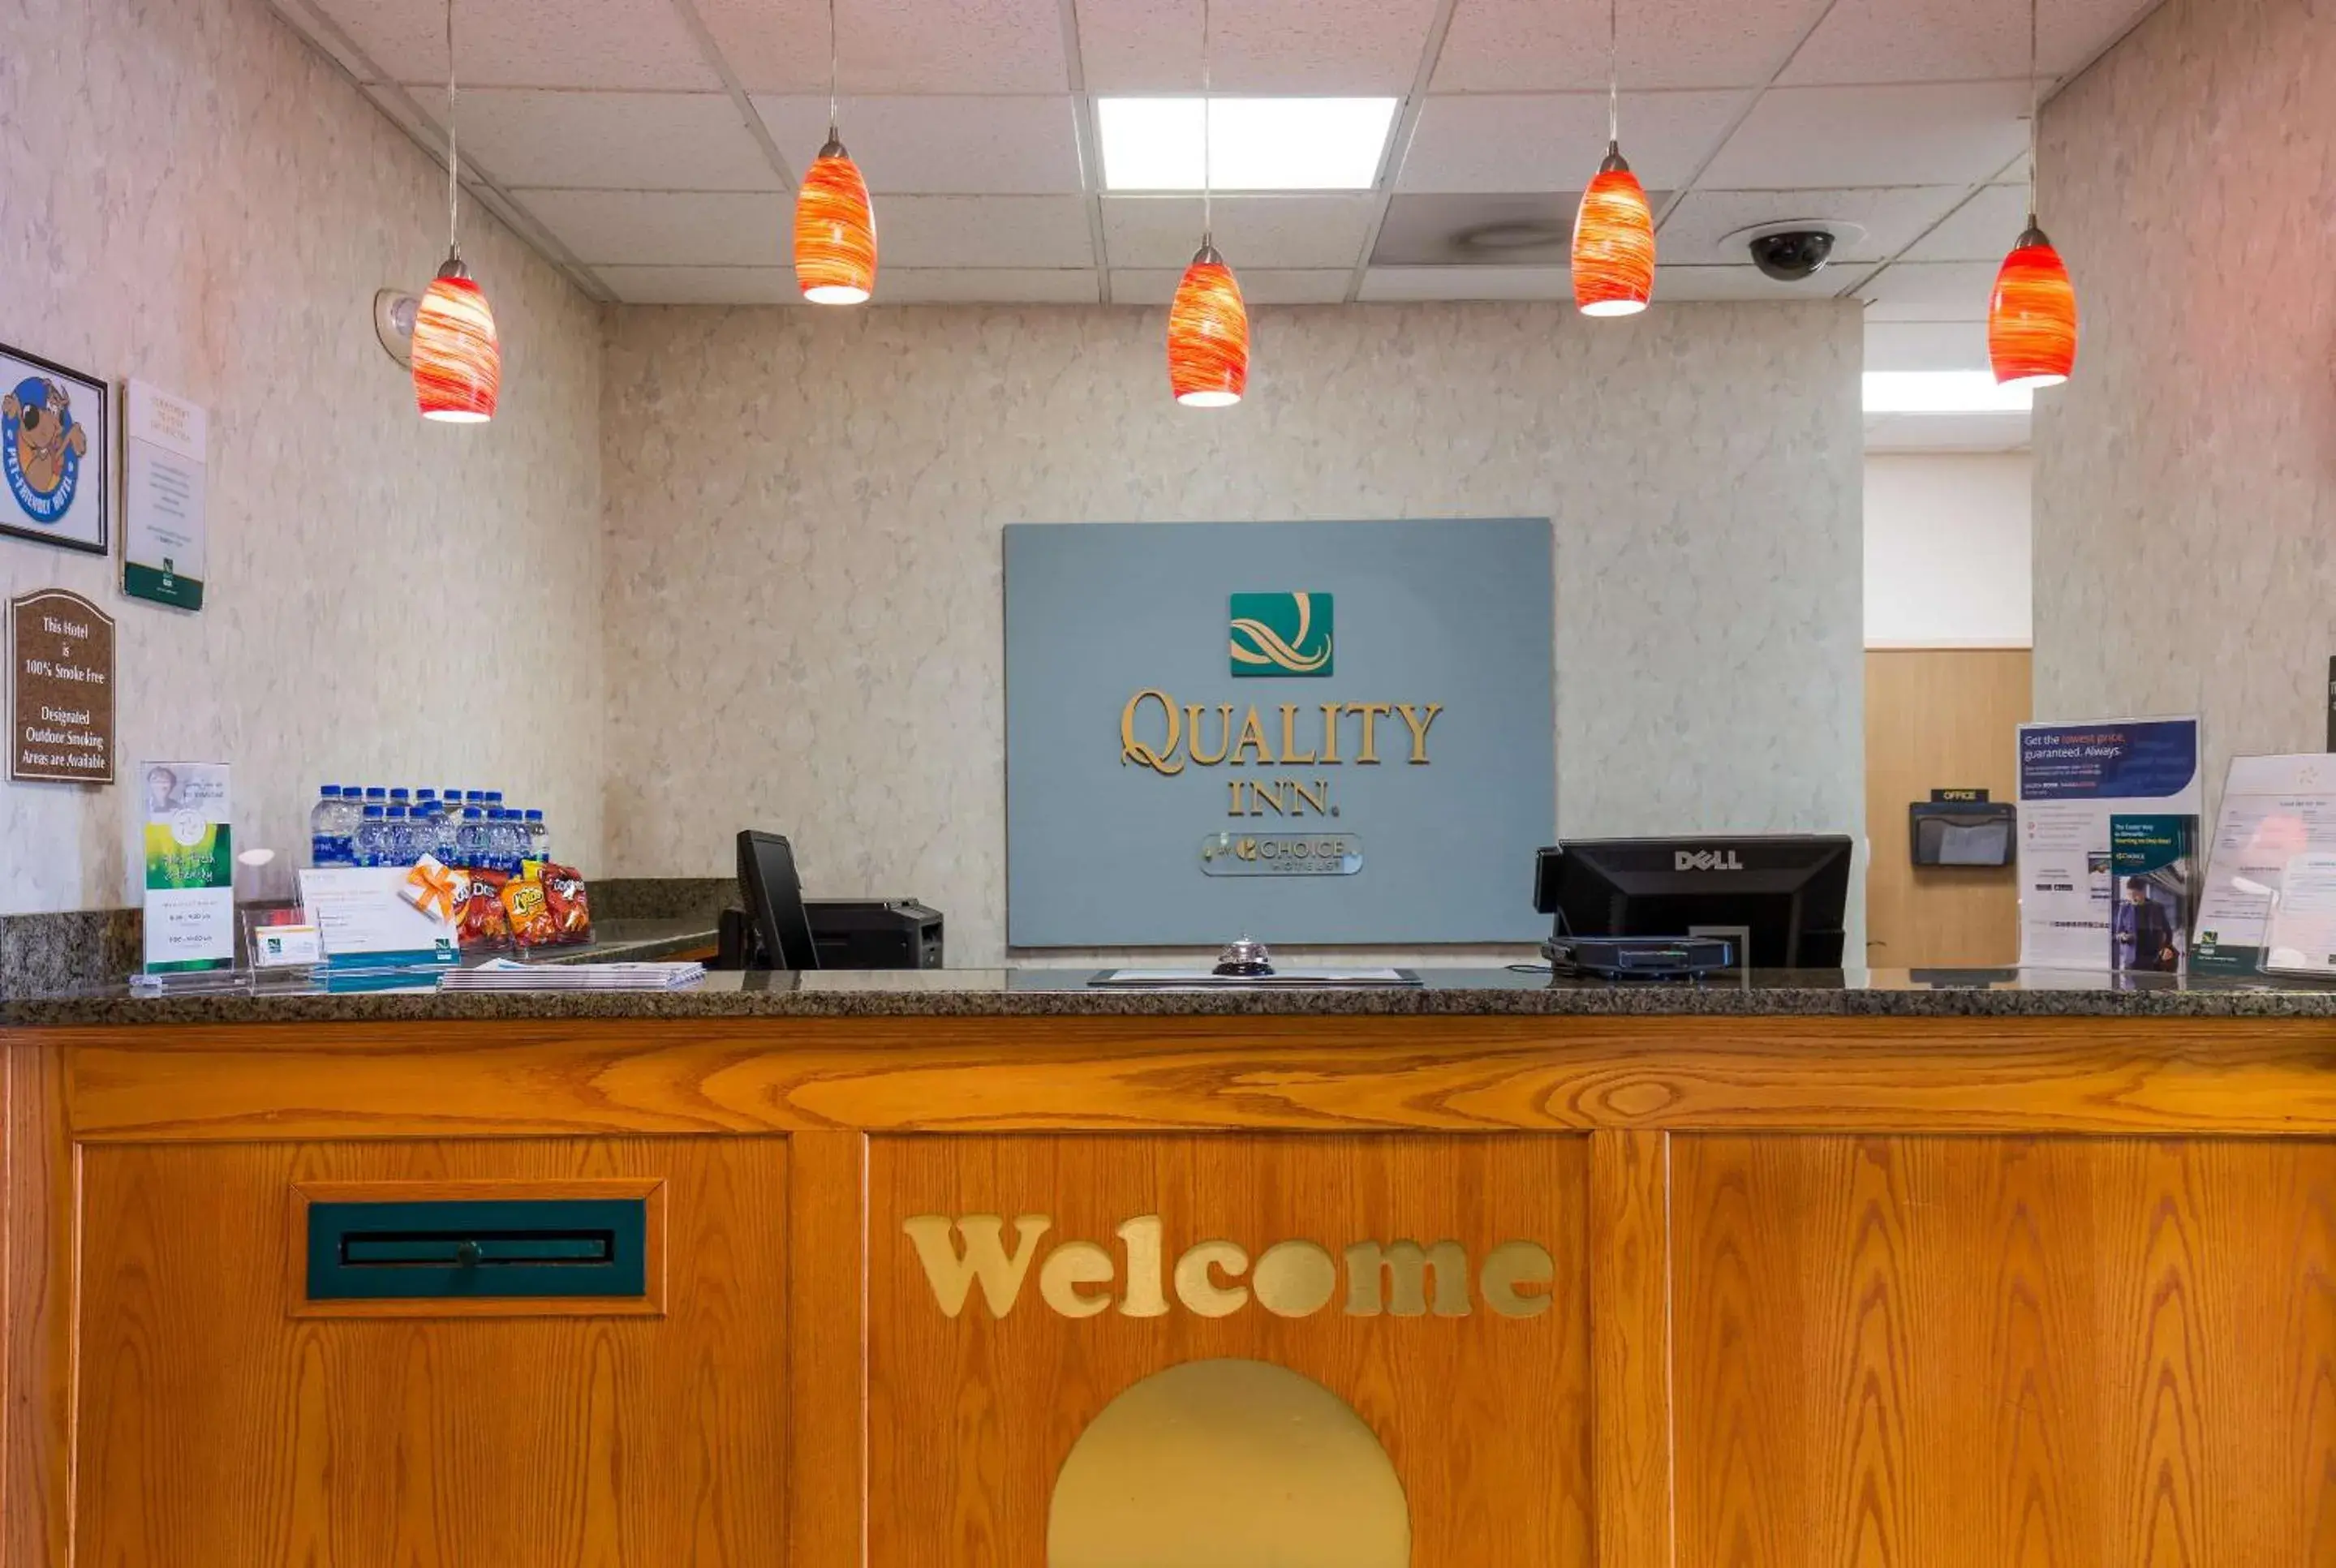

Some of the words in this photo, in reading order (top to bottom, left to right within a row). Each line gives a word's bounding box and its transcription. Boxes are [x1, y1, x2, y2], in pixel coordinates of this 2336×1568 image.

[43, 616, 62, 634] This
[63, 621, 88, 638] Hotel
[62, 642, 70, 658] is
[26, 659, 52, 677] 100%
[55, 664, 84, 682] Smoke
[86, 668, 105, 685] Free
[41, 706, 89, 726] Designated
[26, 727, 66, 744] Outdoor
[67, 730, 104, 752] Smoking
[1120, 687, 1444, 775] QUALITY
[2024, 736, 2042, 746] Get
[2044, 734, 2060, 745] the
[2061, 733, 2095, 744] lowest
[23, 750, 49, 767] Areas
[50, 754, 65, 767] are
[67, 752, 106, 770] Available
[2024, 746, 2083, 763] guaranteed.
[2084, 745, 2123, 759] Always.
[1943, 791, 1977, 800] OFFICE
[1260, 839, 1345, 860] CHOICE
[1674, 849, 1744, 871] DELL
[901, 1213, 1556, 1320] Welcome
